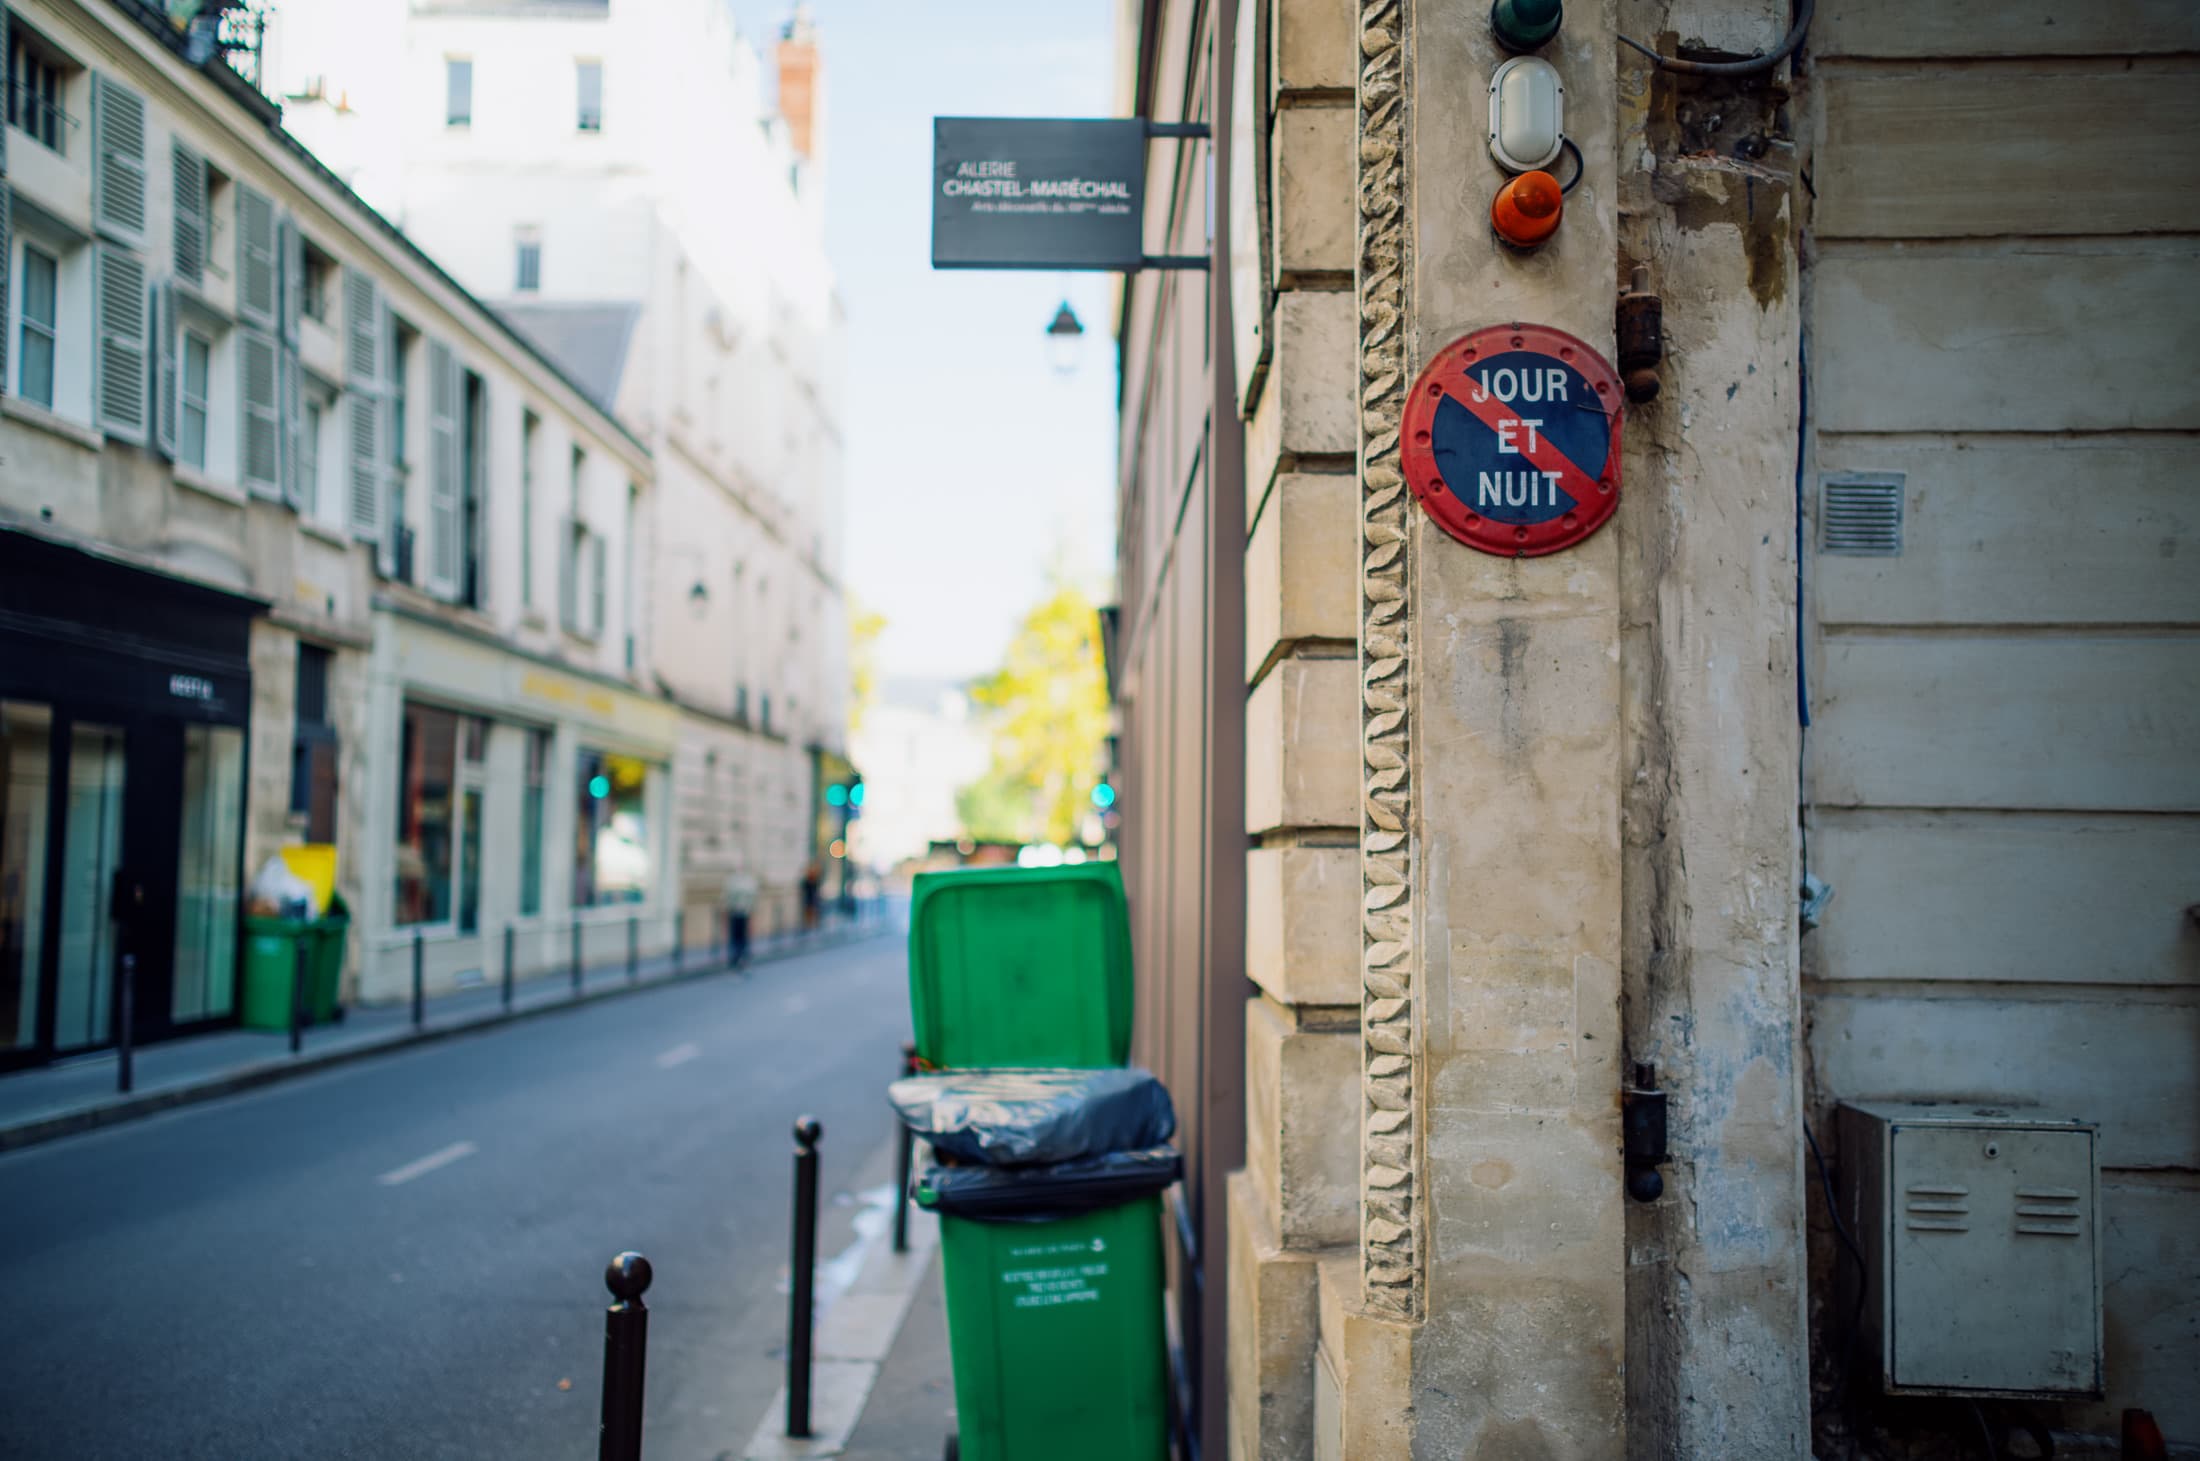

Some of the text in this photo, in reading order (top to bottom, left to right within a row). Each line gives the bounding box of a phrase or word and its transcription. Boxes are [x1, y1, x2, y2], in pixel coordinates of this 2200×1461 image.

[943, 178, 1130, 198] CHASTEL-MARÉCHAL
[1472, 368, 1568, 403] JOUR
[1498, 419, 1543, 453] ET
[1479, 471, 1563, 506] NUIT
